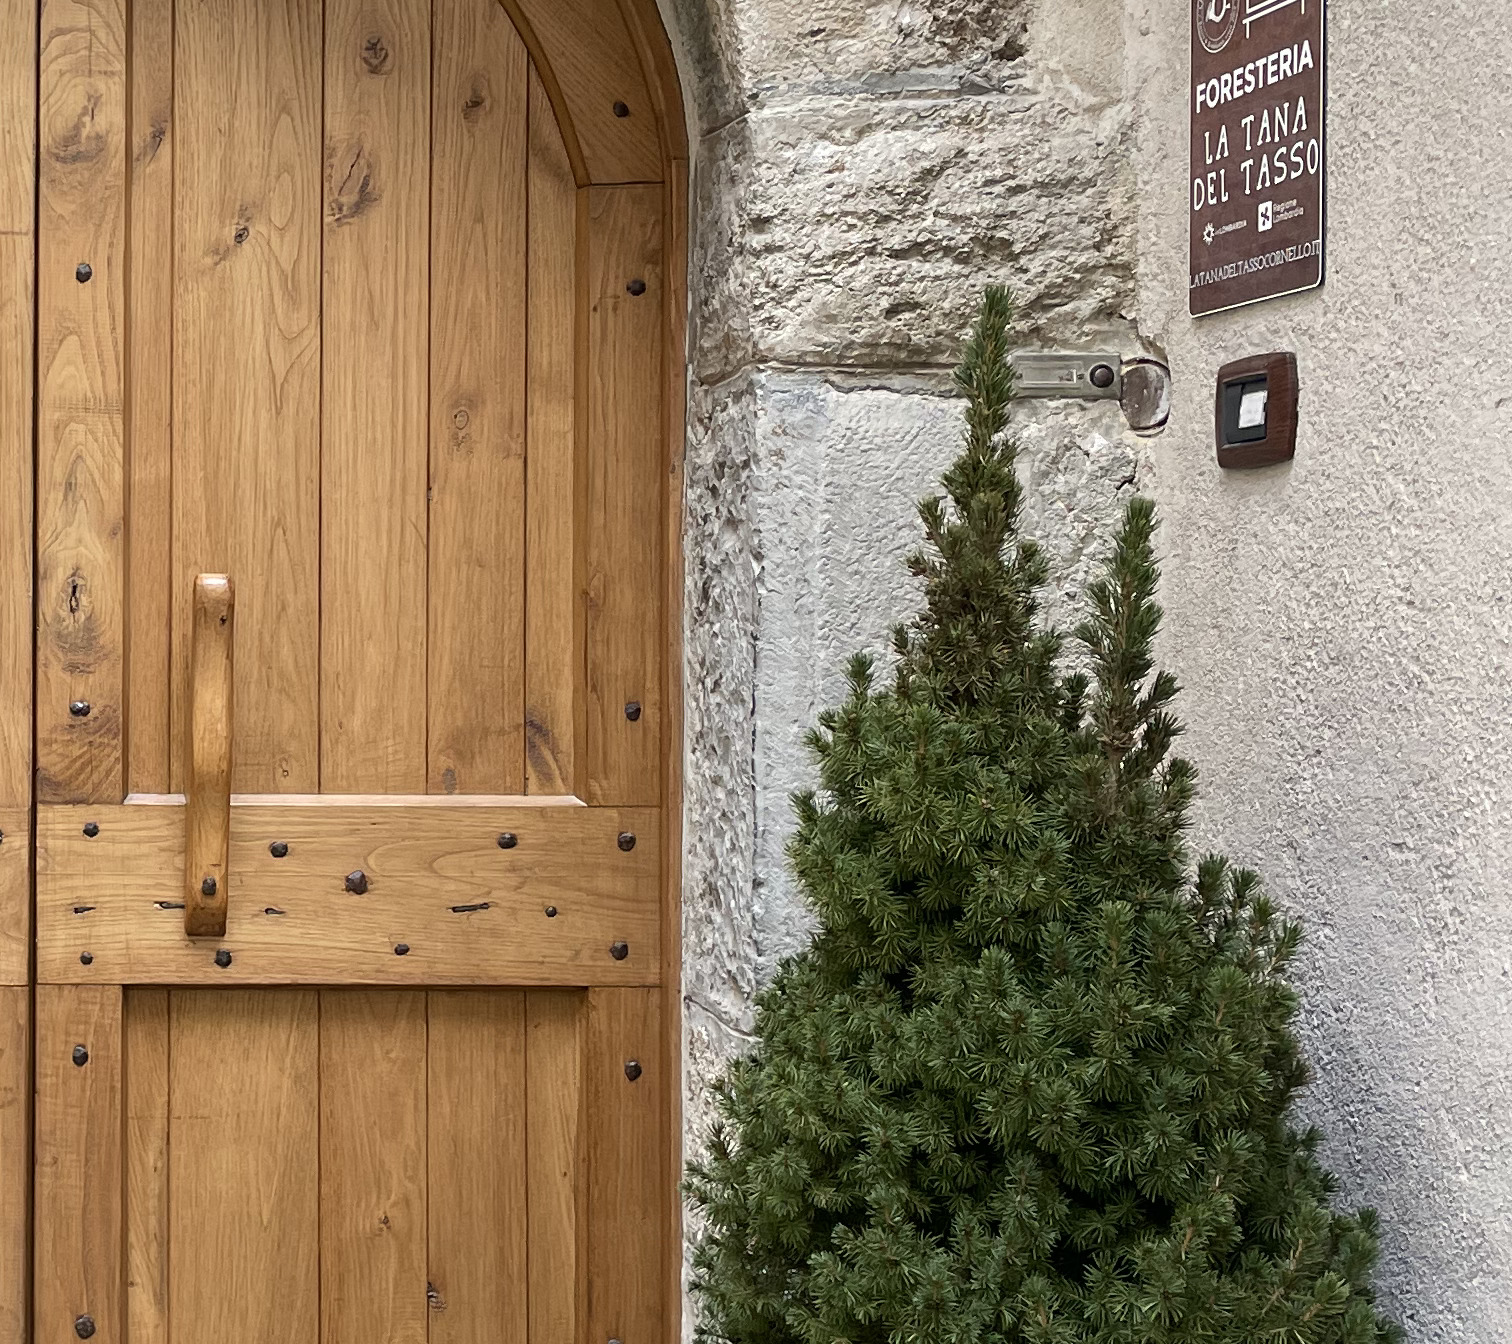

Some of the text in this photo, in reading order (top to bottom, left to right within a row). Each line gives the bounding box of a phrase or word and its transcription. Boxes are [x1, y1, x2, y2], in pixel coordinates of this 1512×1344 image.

[1196, 39, 1314, 114] FORESTERIA
[1204, 95, 1308, 165] LA TANA
[1193, 138, 1319, 211] DEL TASSO
